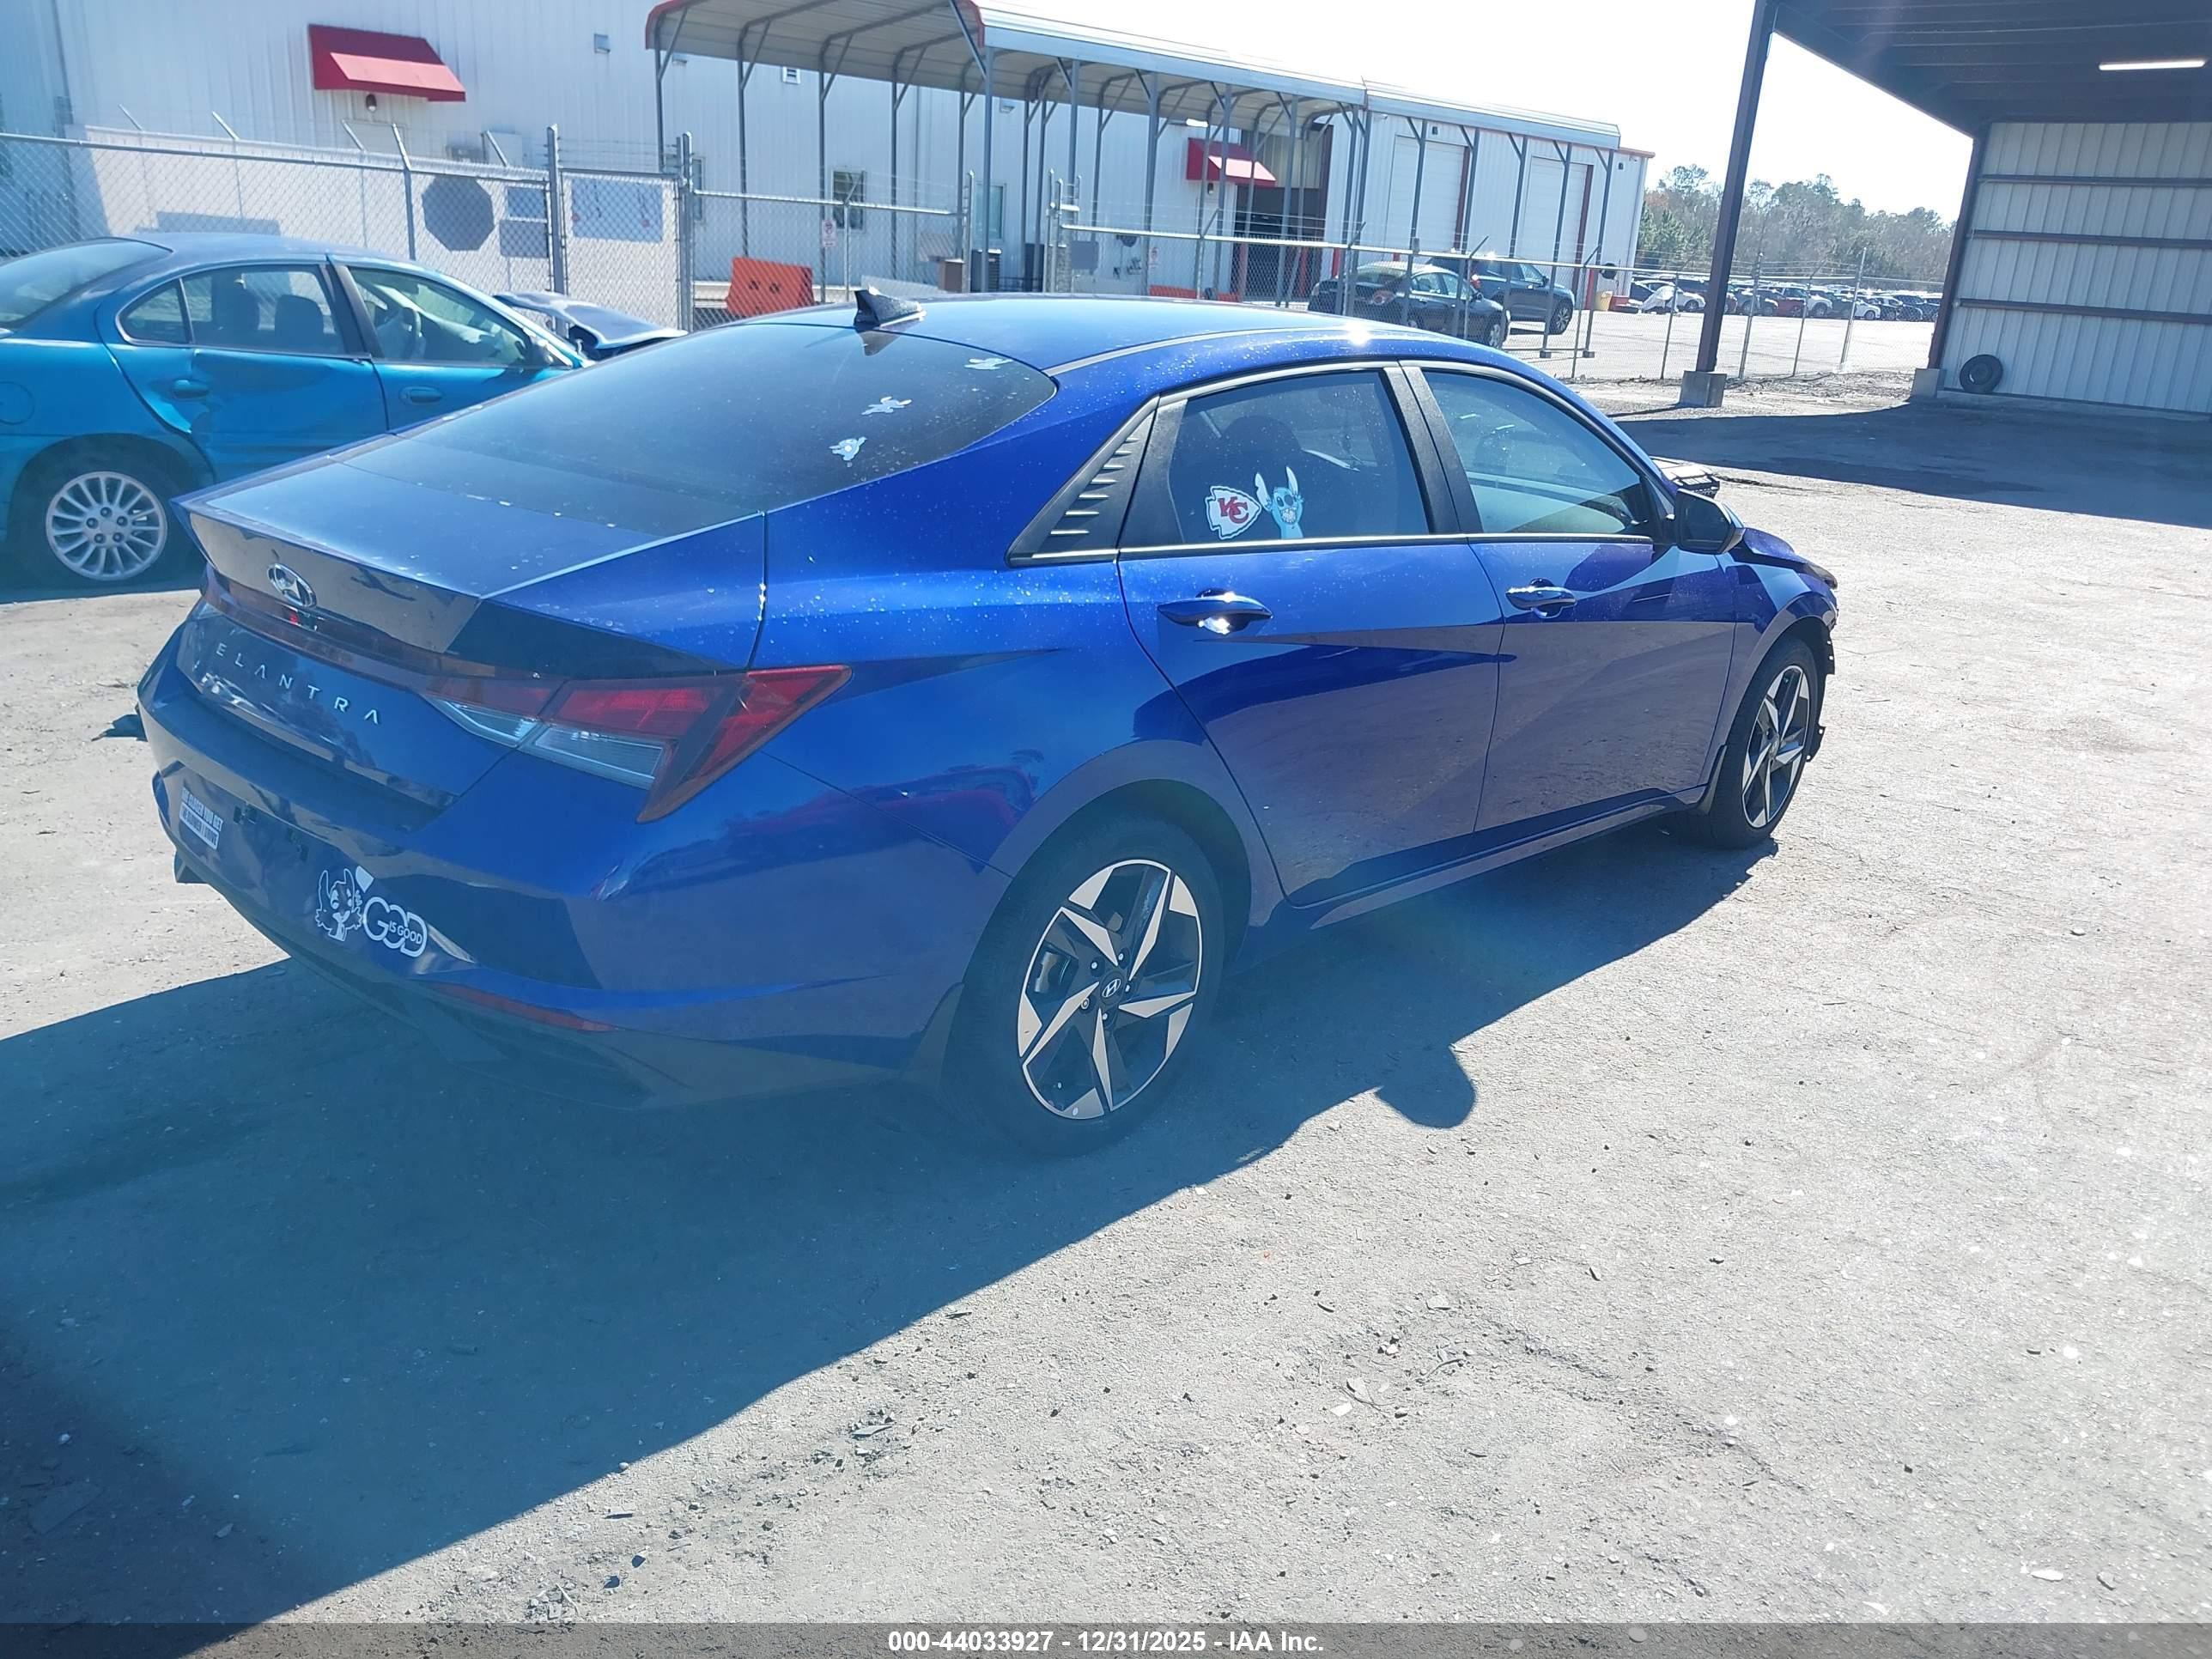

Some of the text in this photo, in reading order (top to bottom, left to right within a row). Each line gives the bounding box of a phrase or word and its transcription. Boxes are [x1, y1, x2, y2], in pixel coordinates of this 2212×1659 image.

[1218, 496, 1249, 524] KC
[216, 642, 379, 725] ELANTRA
[362, 896, 428, 957] GOD
[389, 920, 423, 945] IS GOOD
